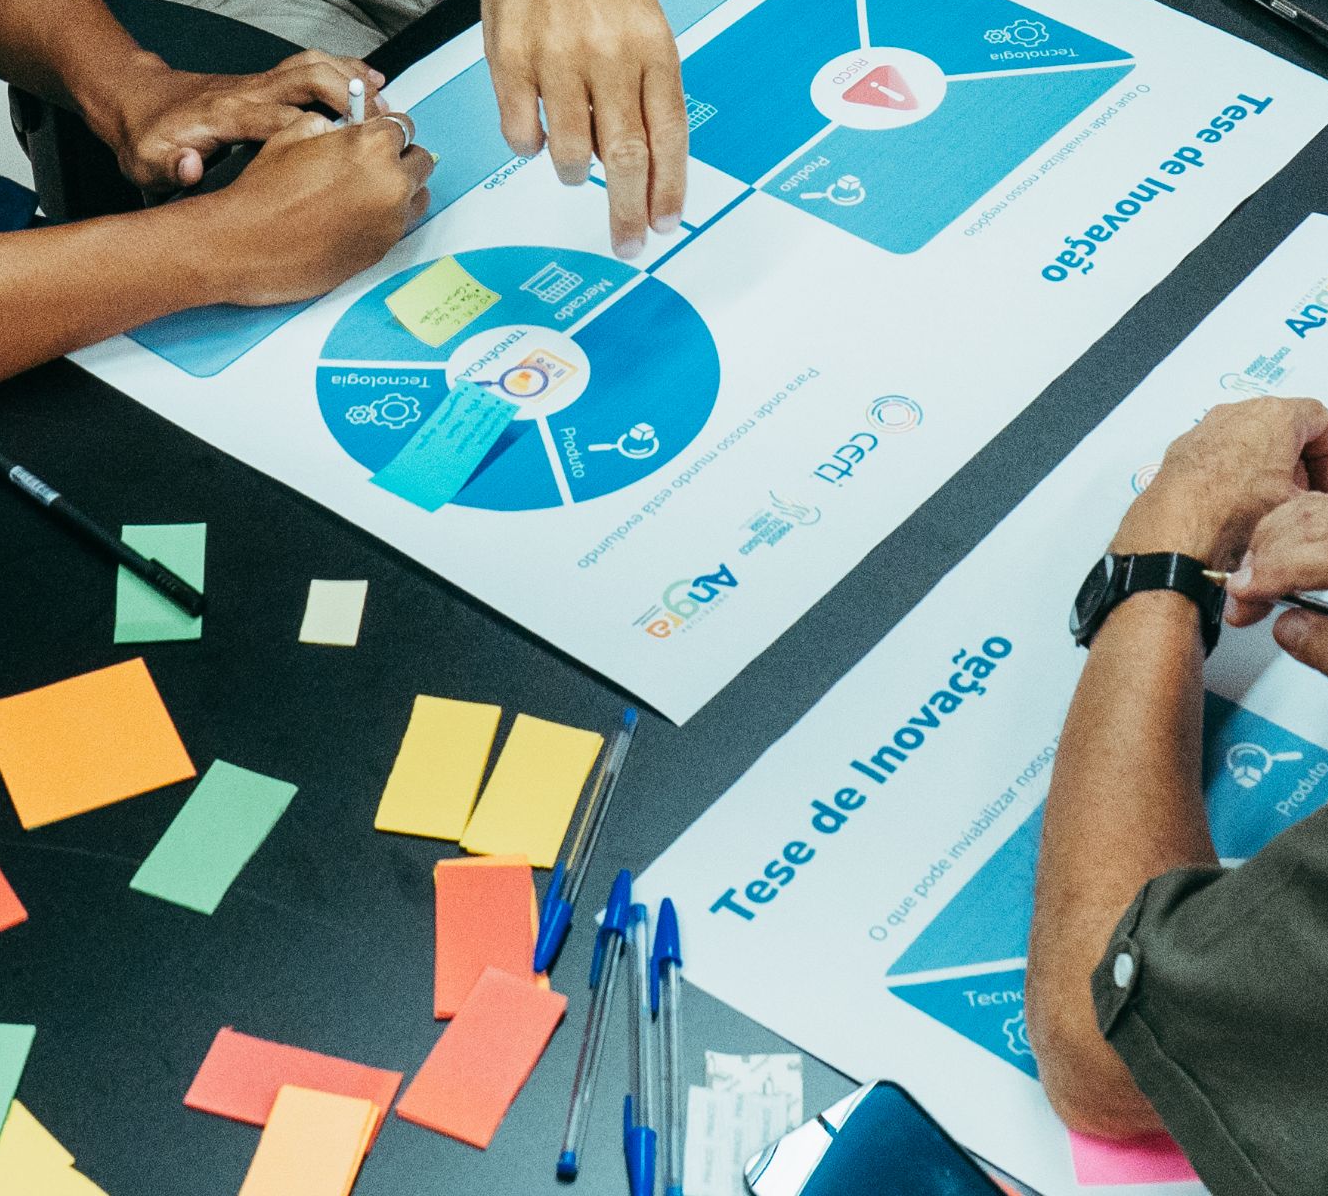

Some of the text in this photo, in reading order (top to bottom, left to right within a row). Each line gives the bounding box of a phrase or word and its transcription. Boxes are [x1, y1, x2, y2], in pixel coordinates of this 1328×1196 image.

[830, 54, 869, 88] RISCO
[989, 42, 1079, 67] Tecnologia
[778, 152, 830, 196] Produto
[960, 79, 1151, 239] O que pode inviabilizar nosso negócio
[1040, 90, 1273, 284] Tese de Inovação
[555, 277, 614, 321] Mercado
[331, 371, 431, 390] Tecnologia
[557, 424, 591, 479] Produto
[576, 362, 820, 570] Para onde nosso mundo está evoluindo
[811, 430, 879, 488] certi
[645, 561, 740, 640] Angra
[710, 632, 1013, 926] Tese de Inovação
[868, 745, 1057, 943] O que pode inviabilizar nosso
[963, 987, 1025, 1008] Tecno
